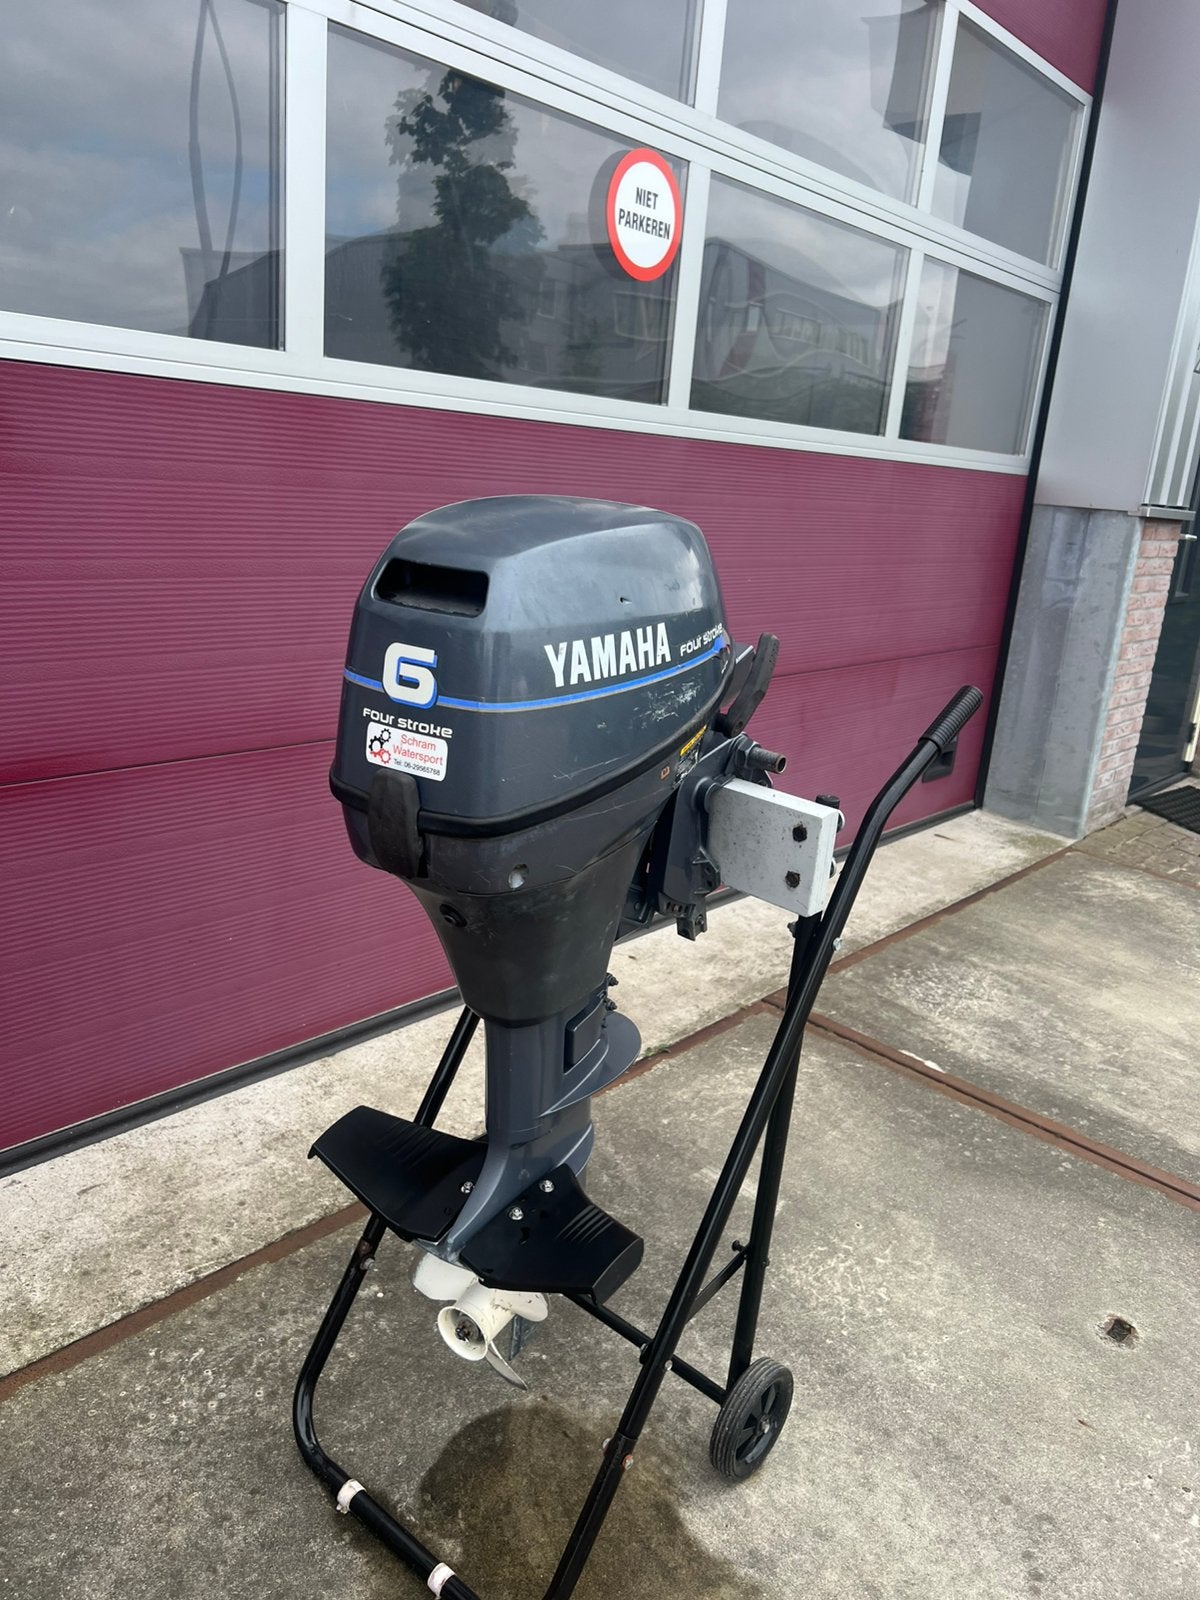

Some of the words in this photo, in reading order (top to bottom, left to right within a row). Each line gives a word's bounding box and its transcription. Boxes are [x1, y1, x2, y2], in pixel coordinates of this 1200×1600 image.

[635, 187, 658, 210] NIET
[619, 207, 671, 240] PARKEREN
[544, 622, 671, 688] YAMAHA
[382, 642, 437, 709] 6
[392, 744, 443, 766] Watersport
[400, 733, 436, 751] Schram
